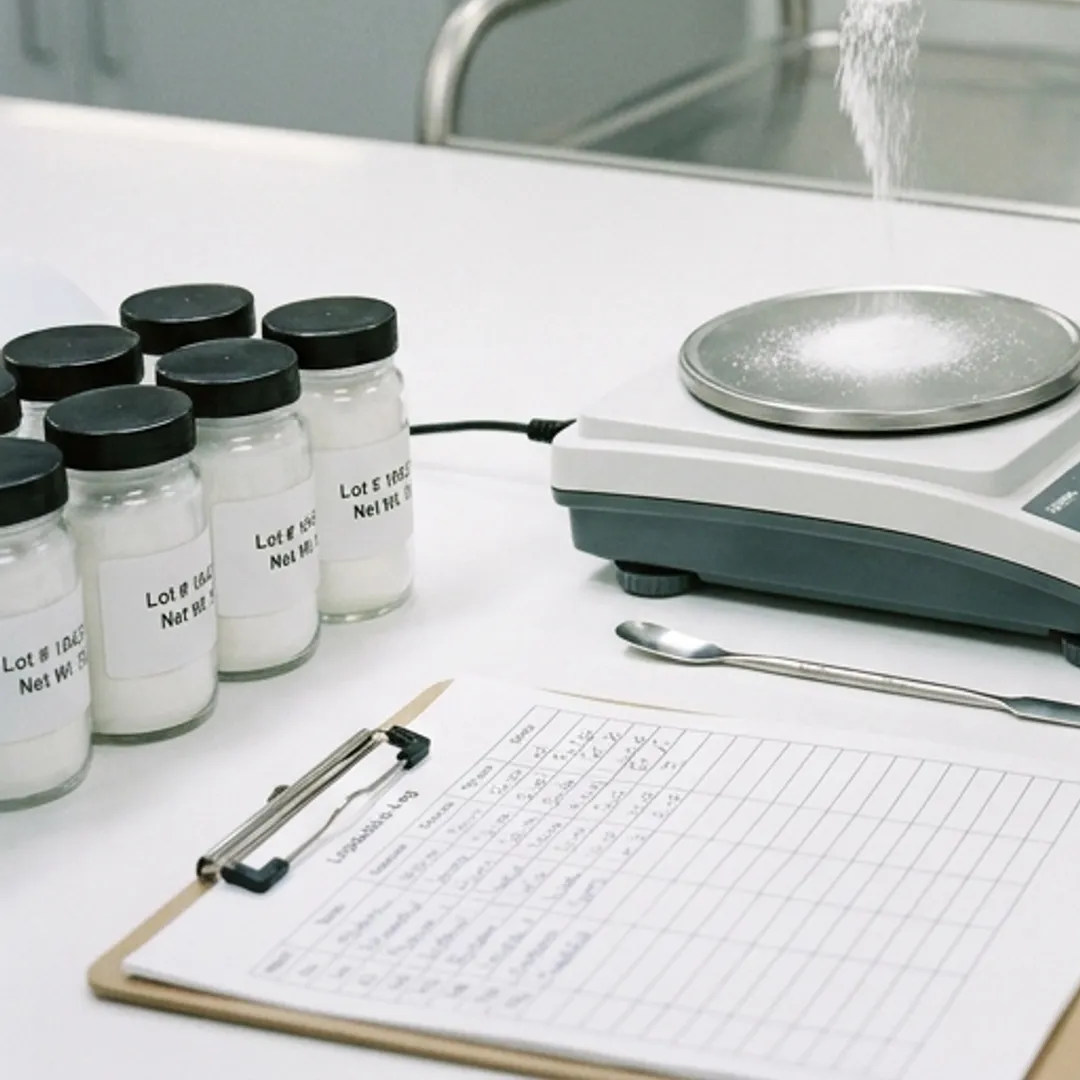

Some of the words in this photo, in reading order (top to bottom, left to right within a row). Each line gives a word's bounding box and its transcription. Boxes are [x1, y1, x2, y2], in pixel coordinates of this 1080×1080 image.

[340, 481, 367, 499] Lot
[255, 529, 282, 549] Lot
[146, 586, 175, 608] Lot
[2, 652, 34, 673] Lot
[19, 672, 50, 695] Net
